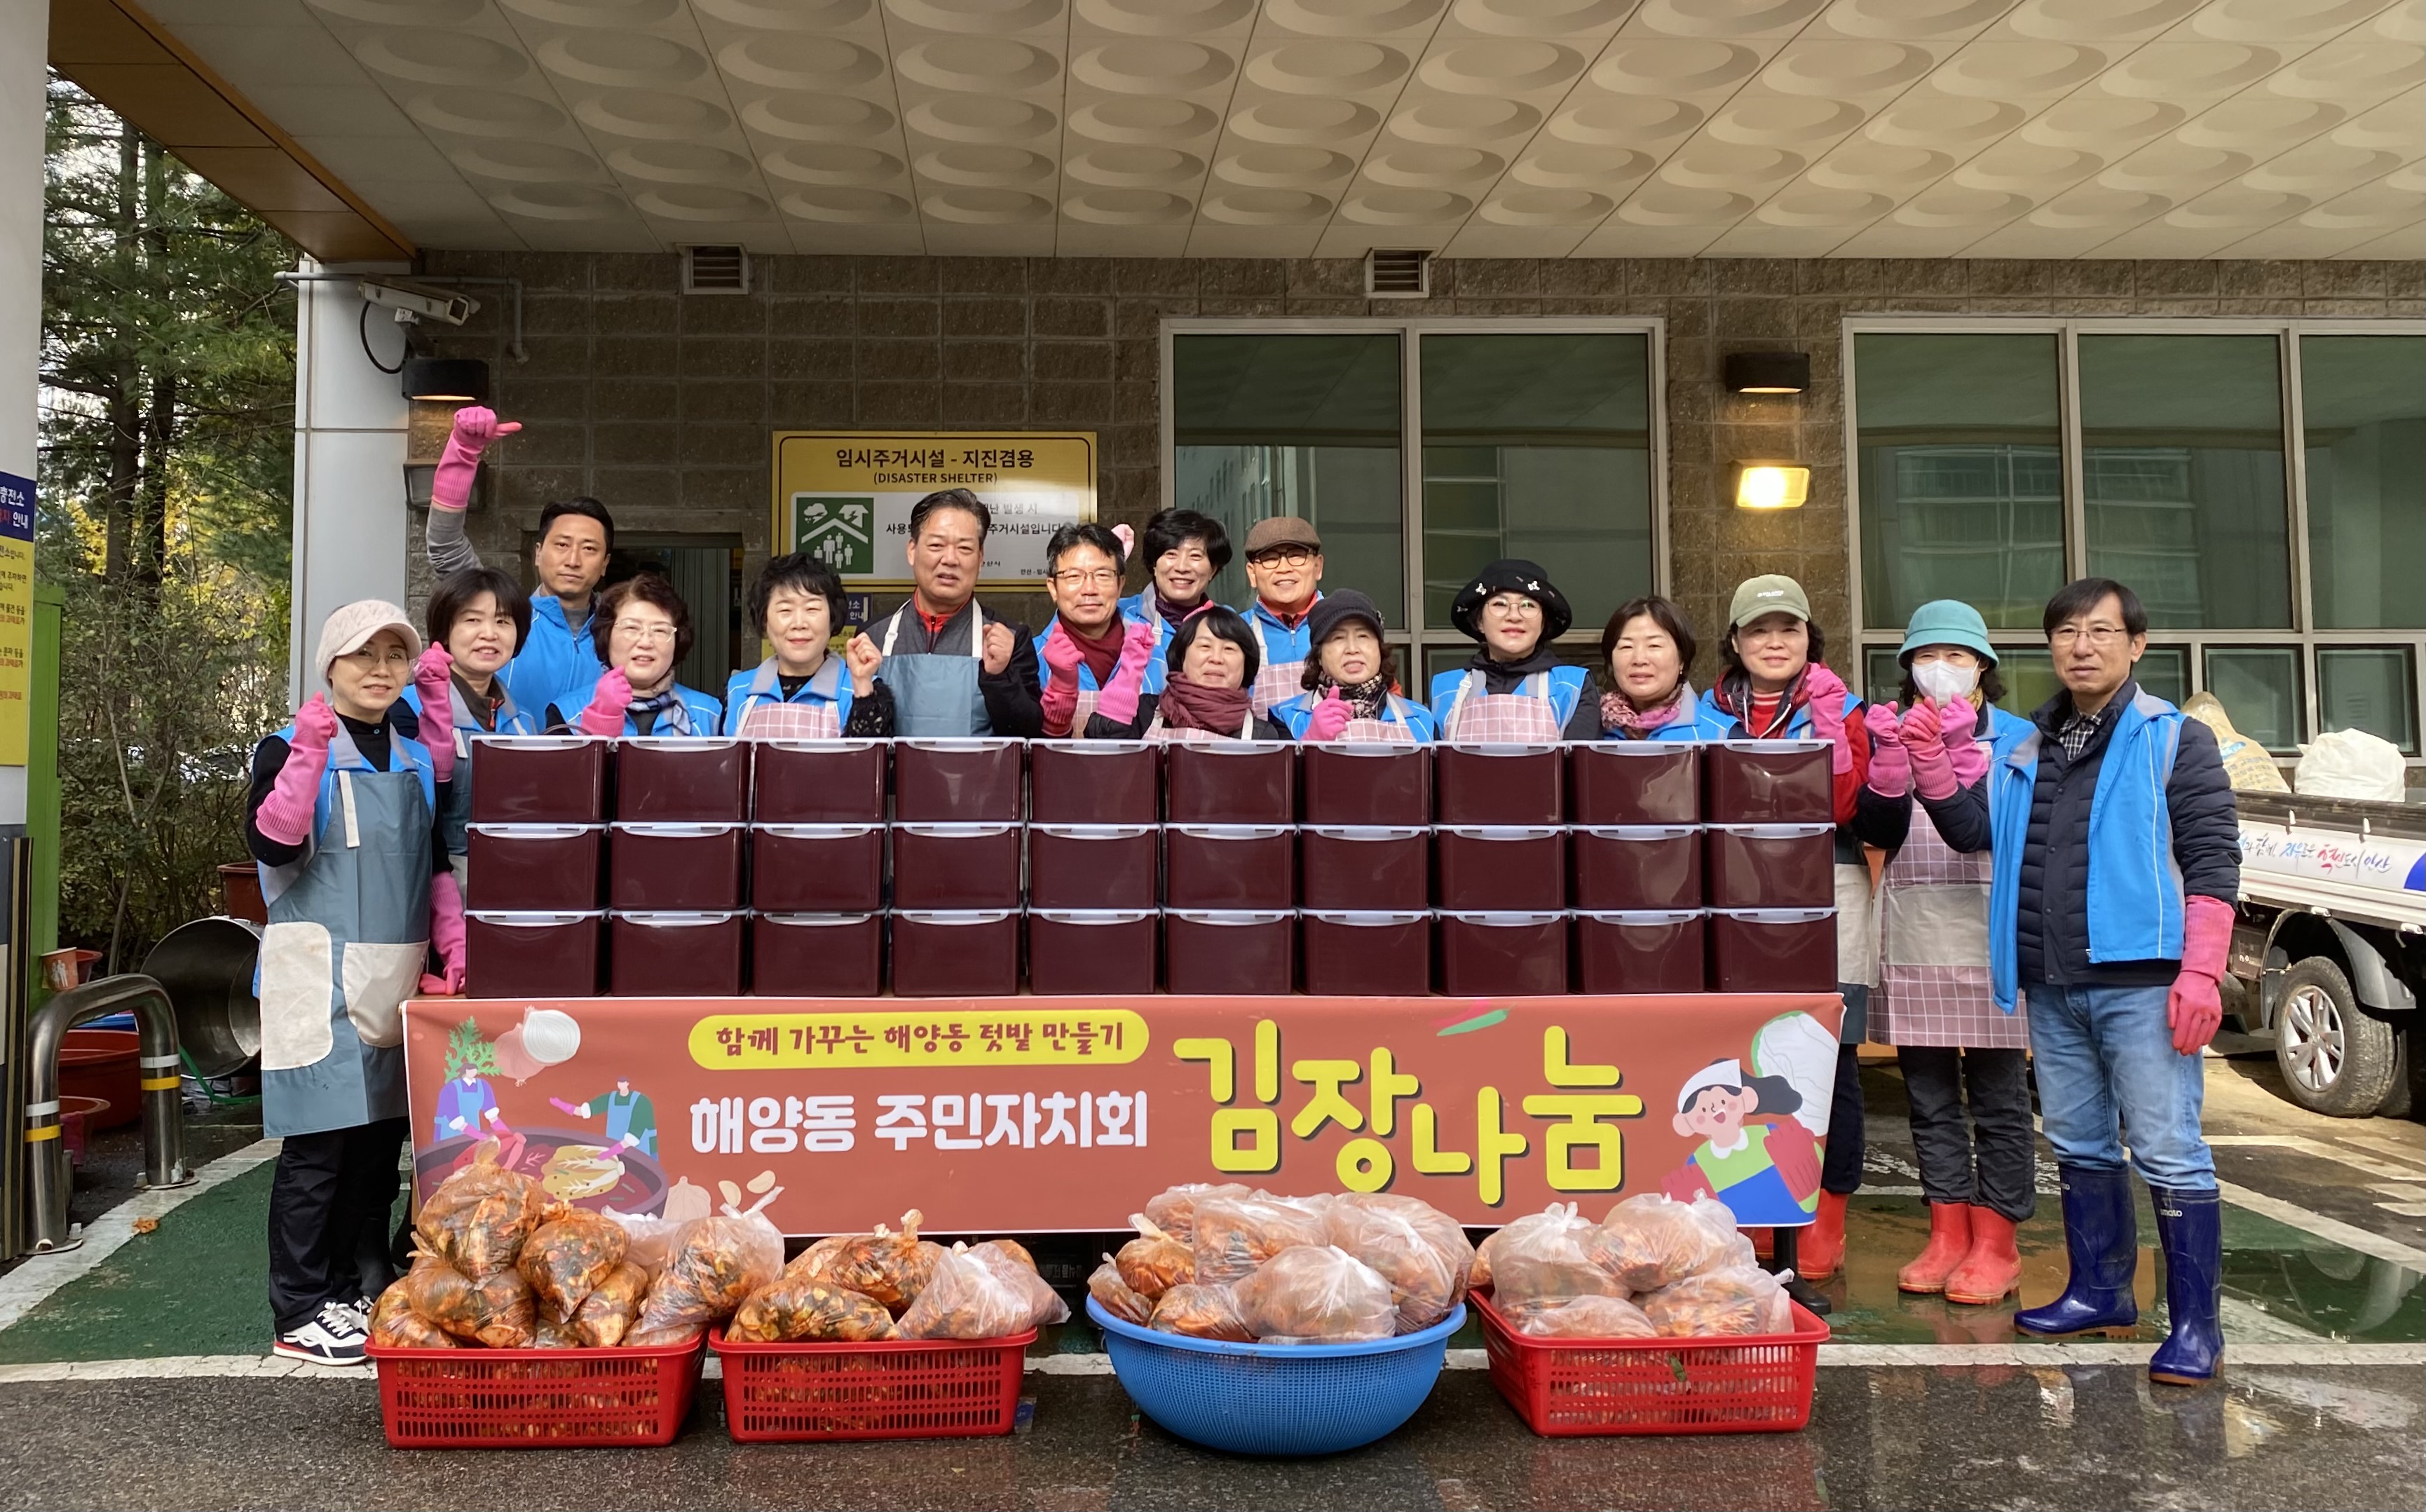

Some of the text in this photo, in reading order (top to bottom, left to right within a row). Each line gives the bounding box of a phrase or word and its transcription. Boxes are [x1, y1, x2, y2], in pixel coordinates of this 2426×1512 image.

[836, 449, 945, 468] 임시주거시설
[962, 449, 1035, 468] 지진겸용
[873, 472, 997, 485] (DISASTER SHELTER)
[1003, 503, 1023, 515] 발생
[1028, 503, 1037, 515] 시
[13, 511, 28, 529] 안내
[2364, 853, 2392, 873] 안산
[716, 1021, 1124, 1056] 함께 가꾸는 해양동 텃밭 만들기
[690, 1090, 1147, 1154] 해양동 주민자치회
[1173, 1019, 1644, 1206] 김장나눔
